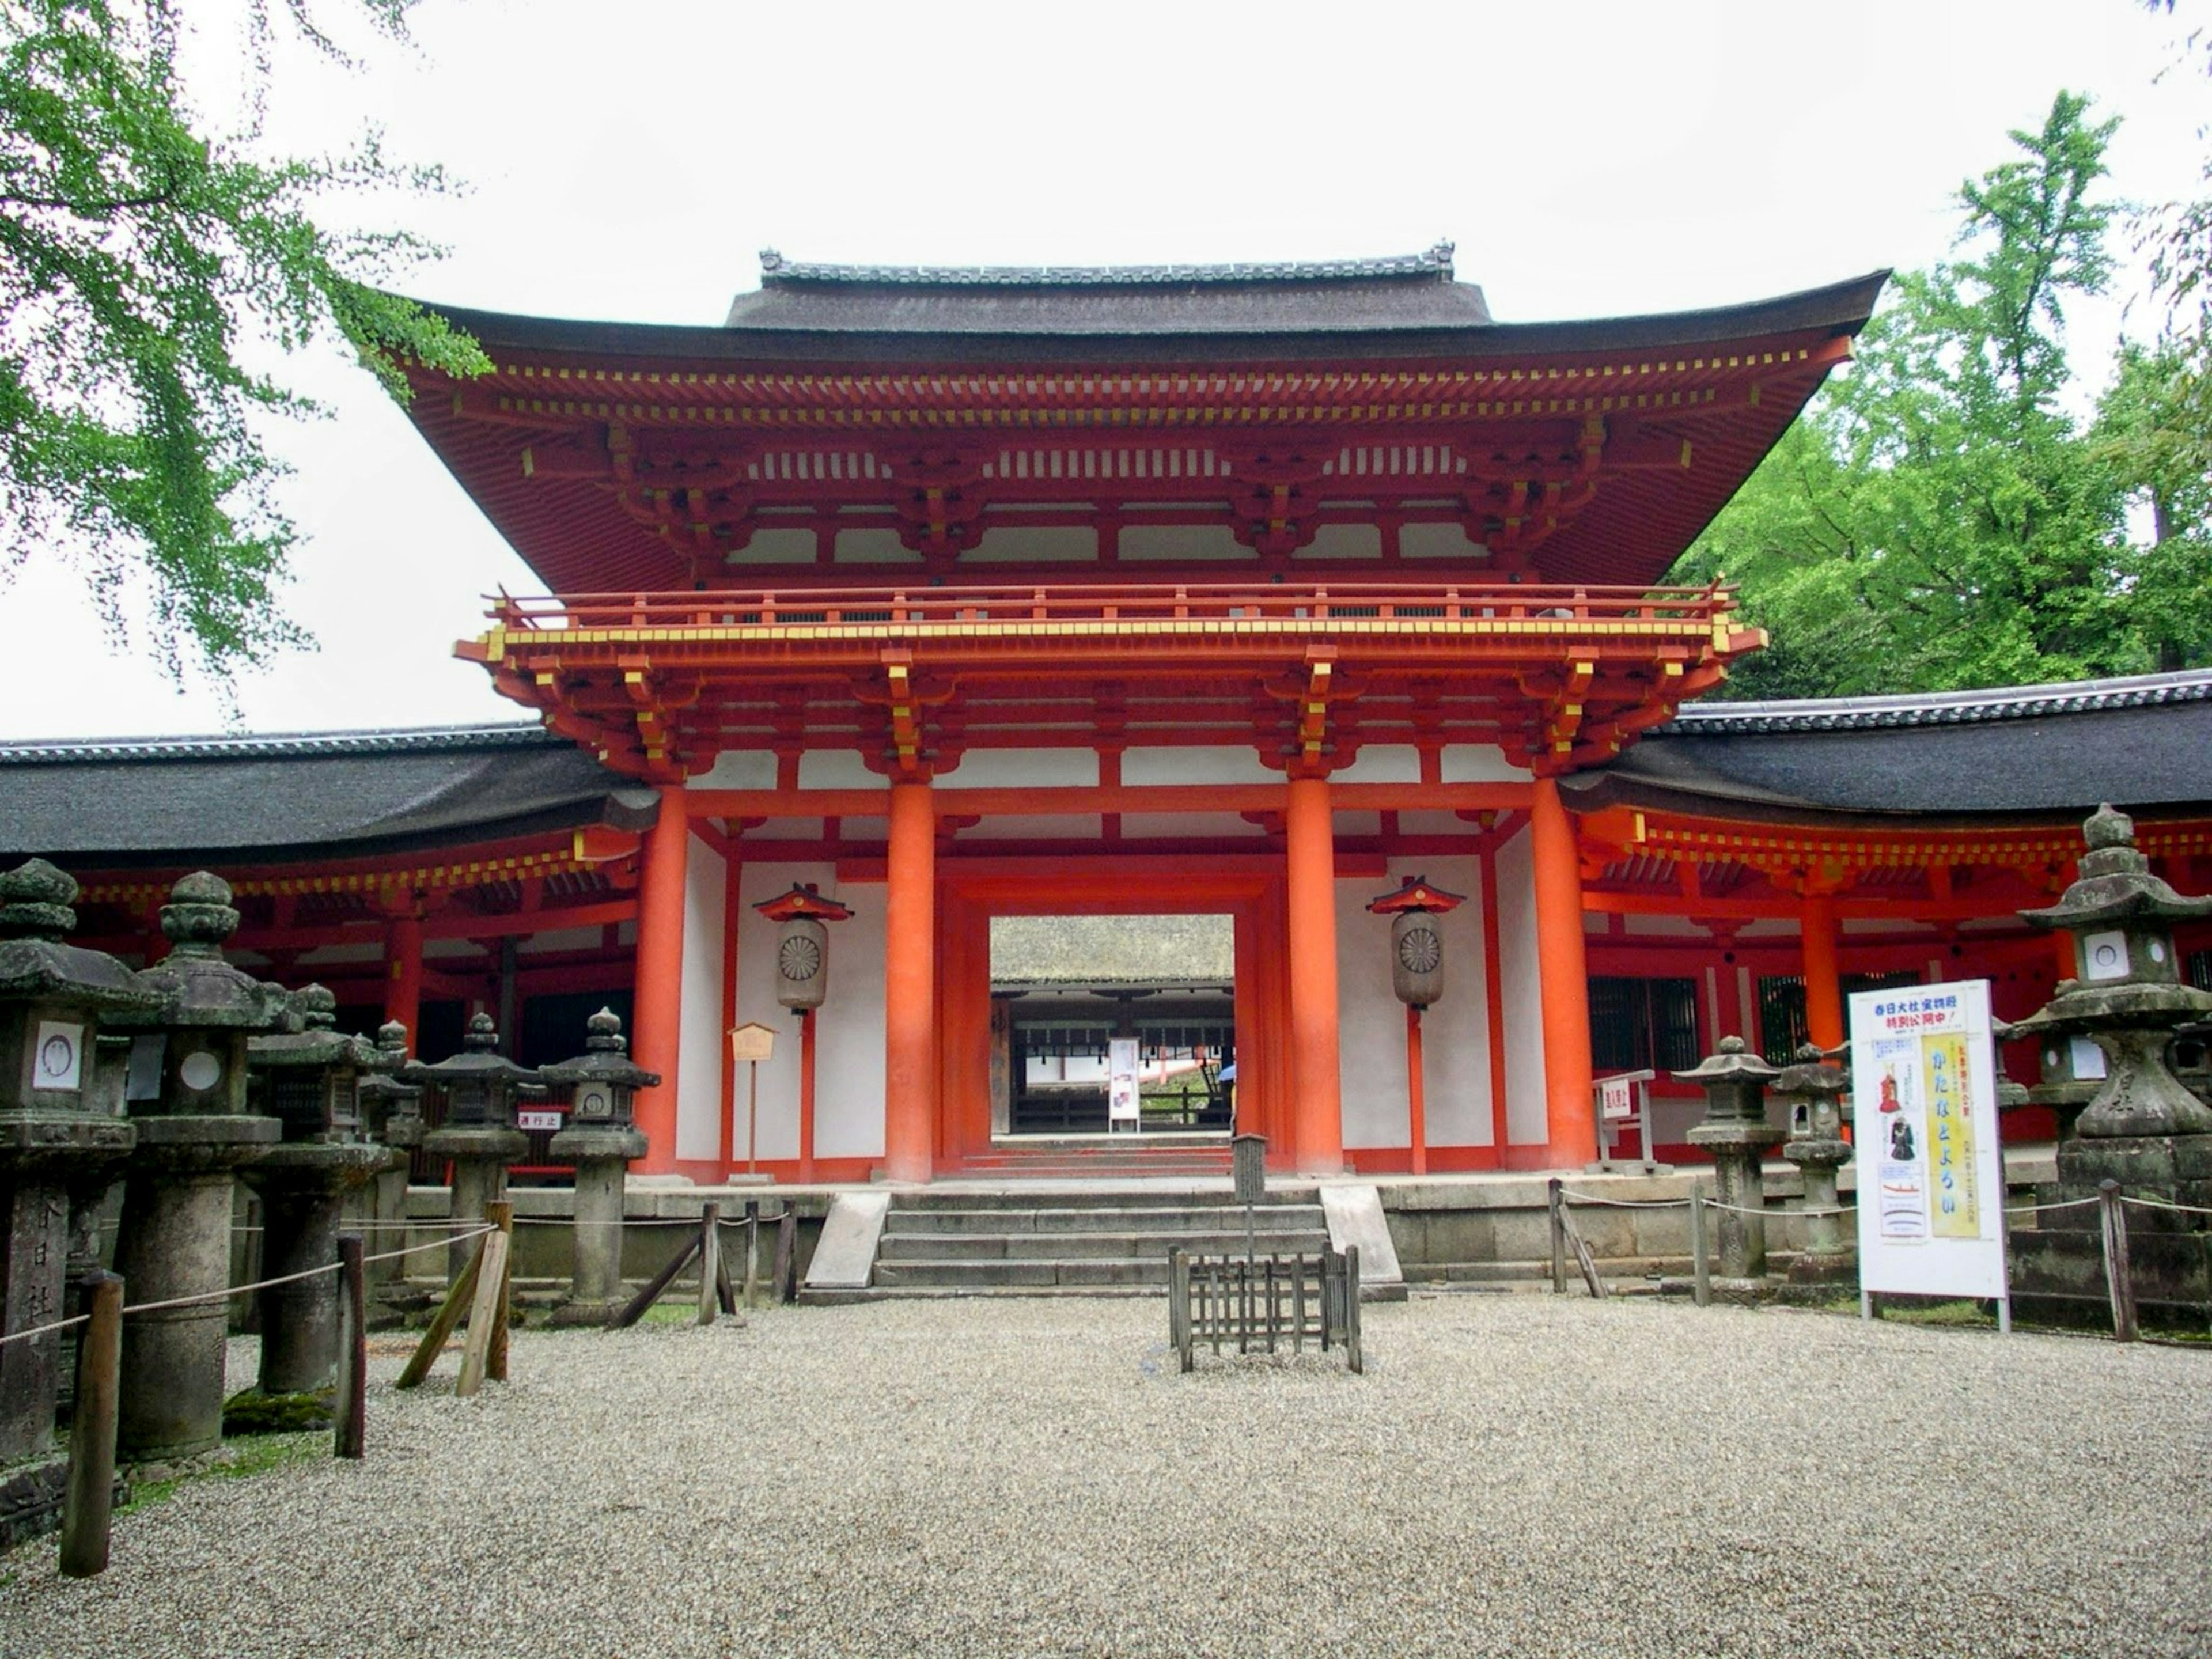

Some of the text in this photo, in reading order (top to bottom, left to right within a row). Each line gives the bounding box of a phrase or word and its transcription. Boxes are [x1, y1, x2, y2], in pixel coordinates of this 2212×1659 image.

[1932, 1050, 1955, 1214] かたなとよろい
